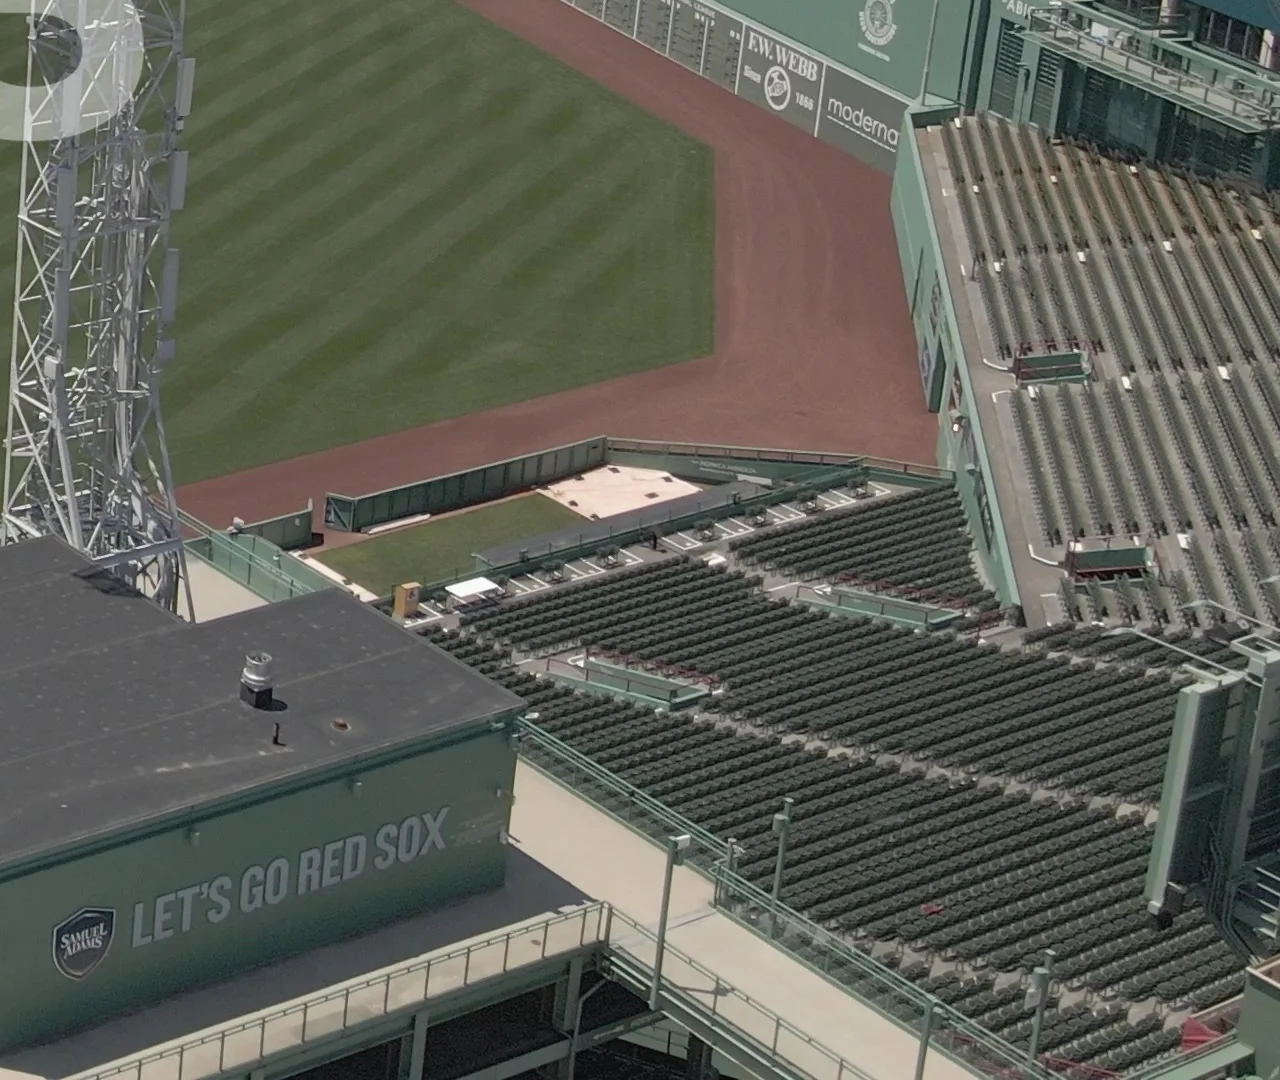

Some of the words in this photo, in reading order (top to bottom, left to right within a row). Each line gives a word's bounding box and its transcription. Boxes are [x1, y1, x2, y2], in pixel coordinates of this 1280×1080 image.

[775, 44, 818, 82] WEBB
[827, 98, 899, 145] moderna
[132, 875, 232, 948] LET'S
[240, 857, 290, 913] GO
[297, 834, 368, 896] RED
[373, 806, 450, 871] SOX
[60, 922, 108, 949] SAMUEL
[63, 936, 103, 960] ADAMS
